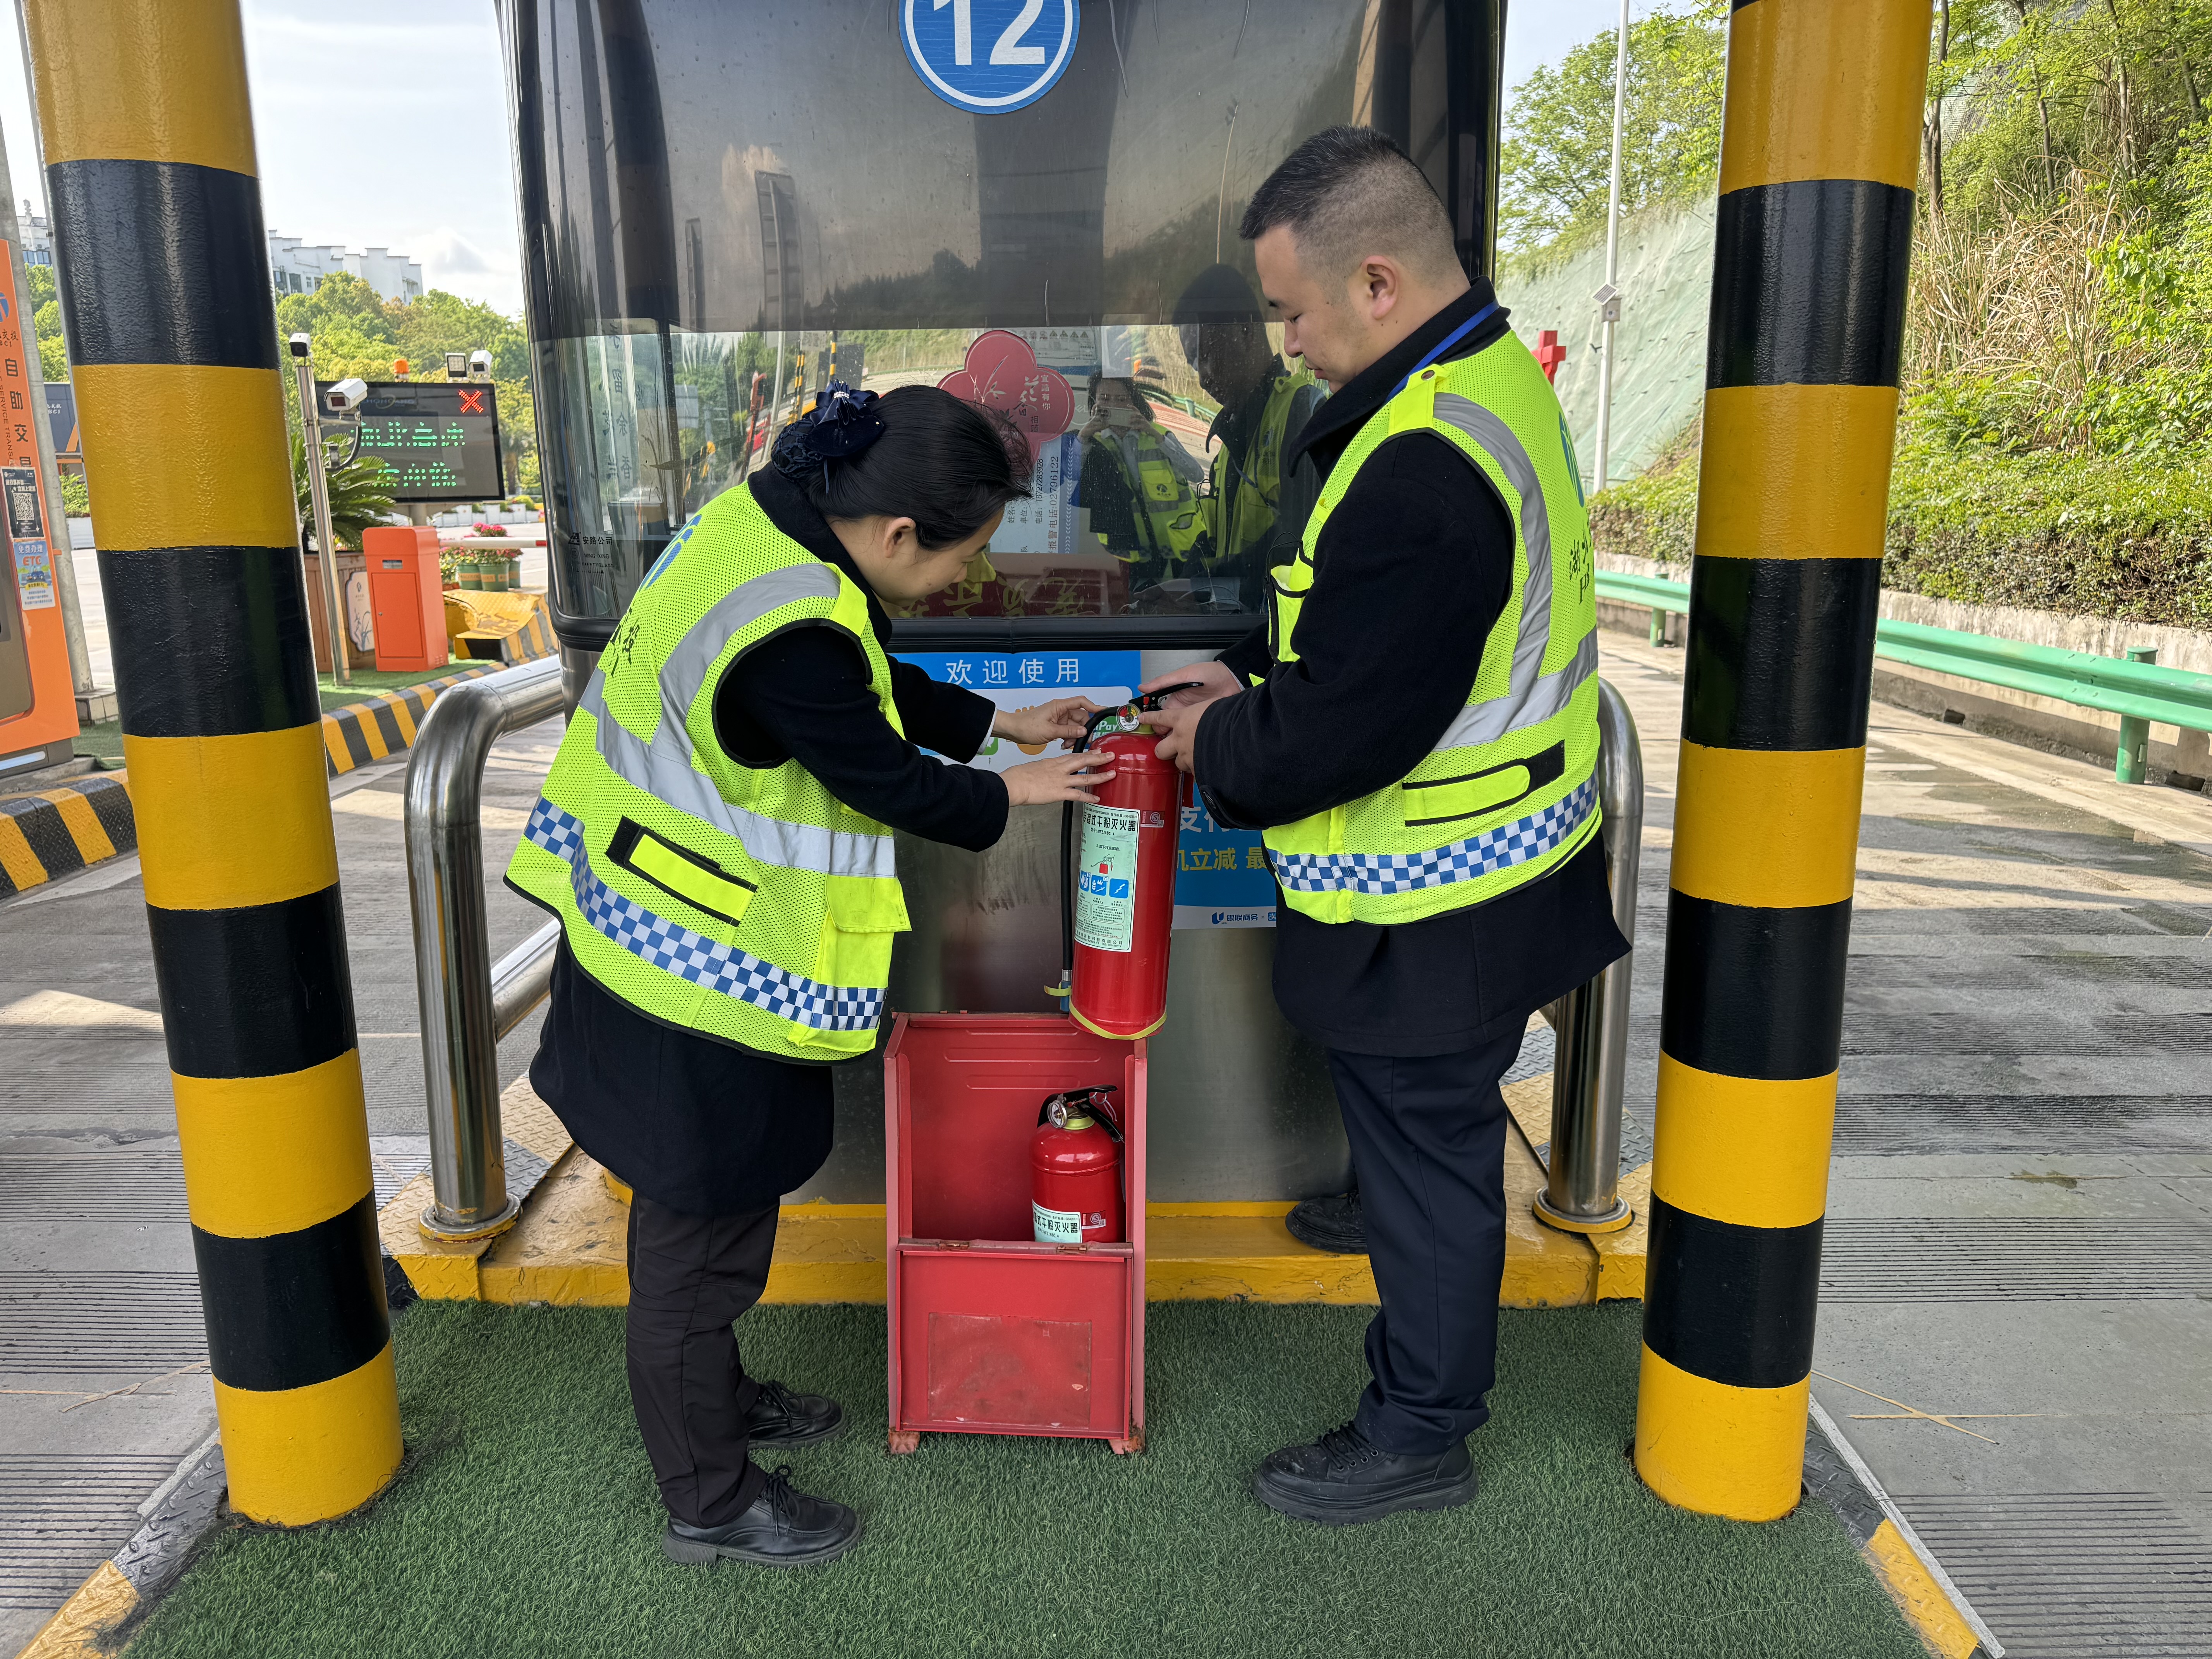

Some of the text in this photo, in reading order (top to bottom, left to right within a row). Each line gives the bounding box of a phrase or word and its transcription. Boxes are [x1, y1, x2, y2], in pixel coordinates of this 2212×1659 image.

[934, 0, 1045, 65] 12
[0, 329, 19, 341] 交投
[22, 556, 42, 566] ETC
[946, 658, 1079, 685] 欢迎使用
